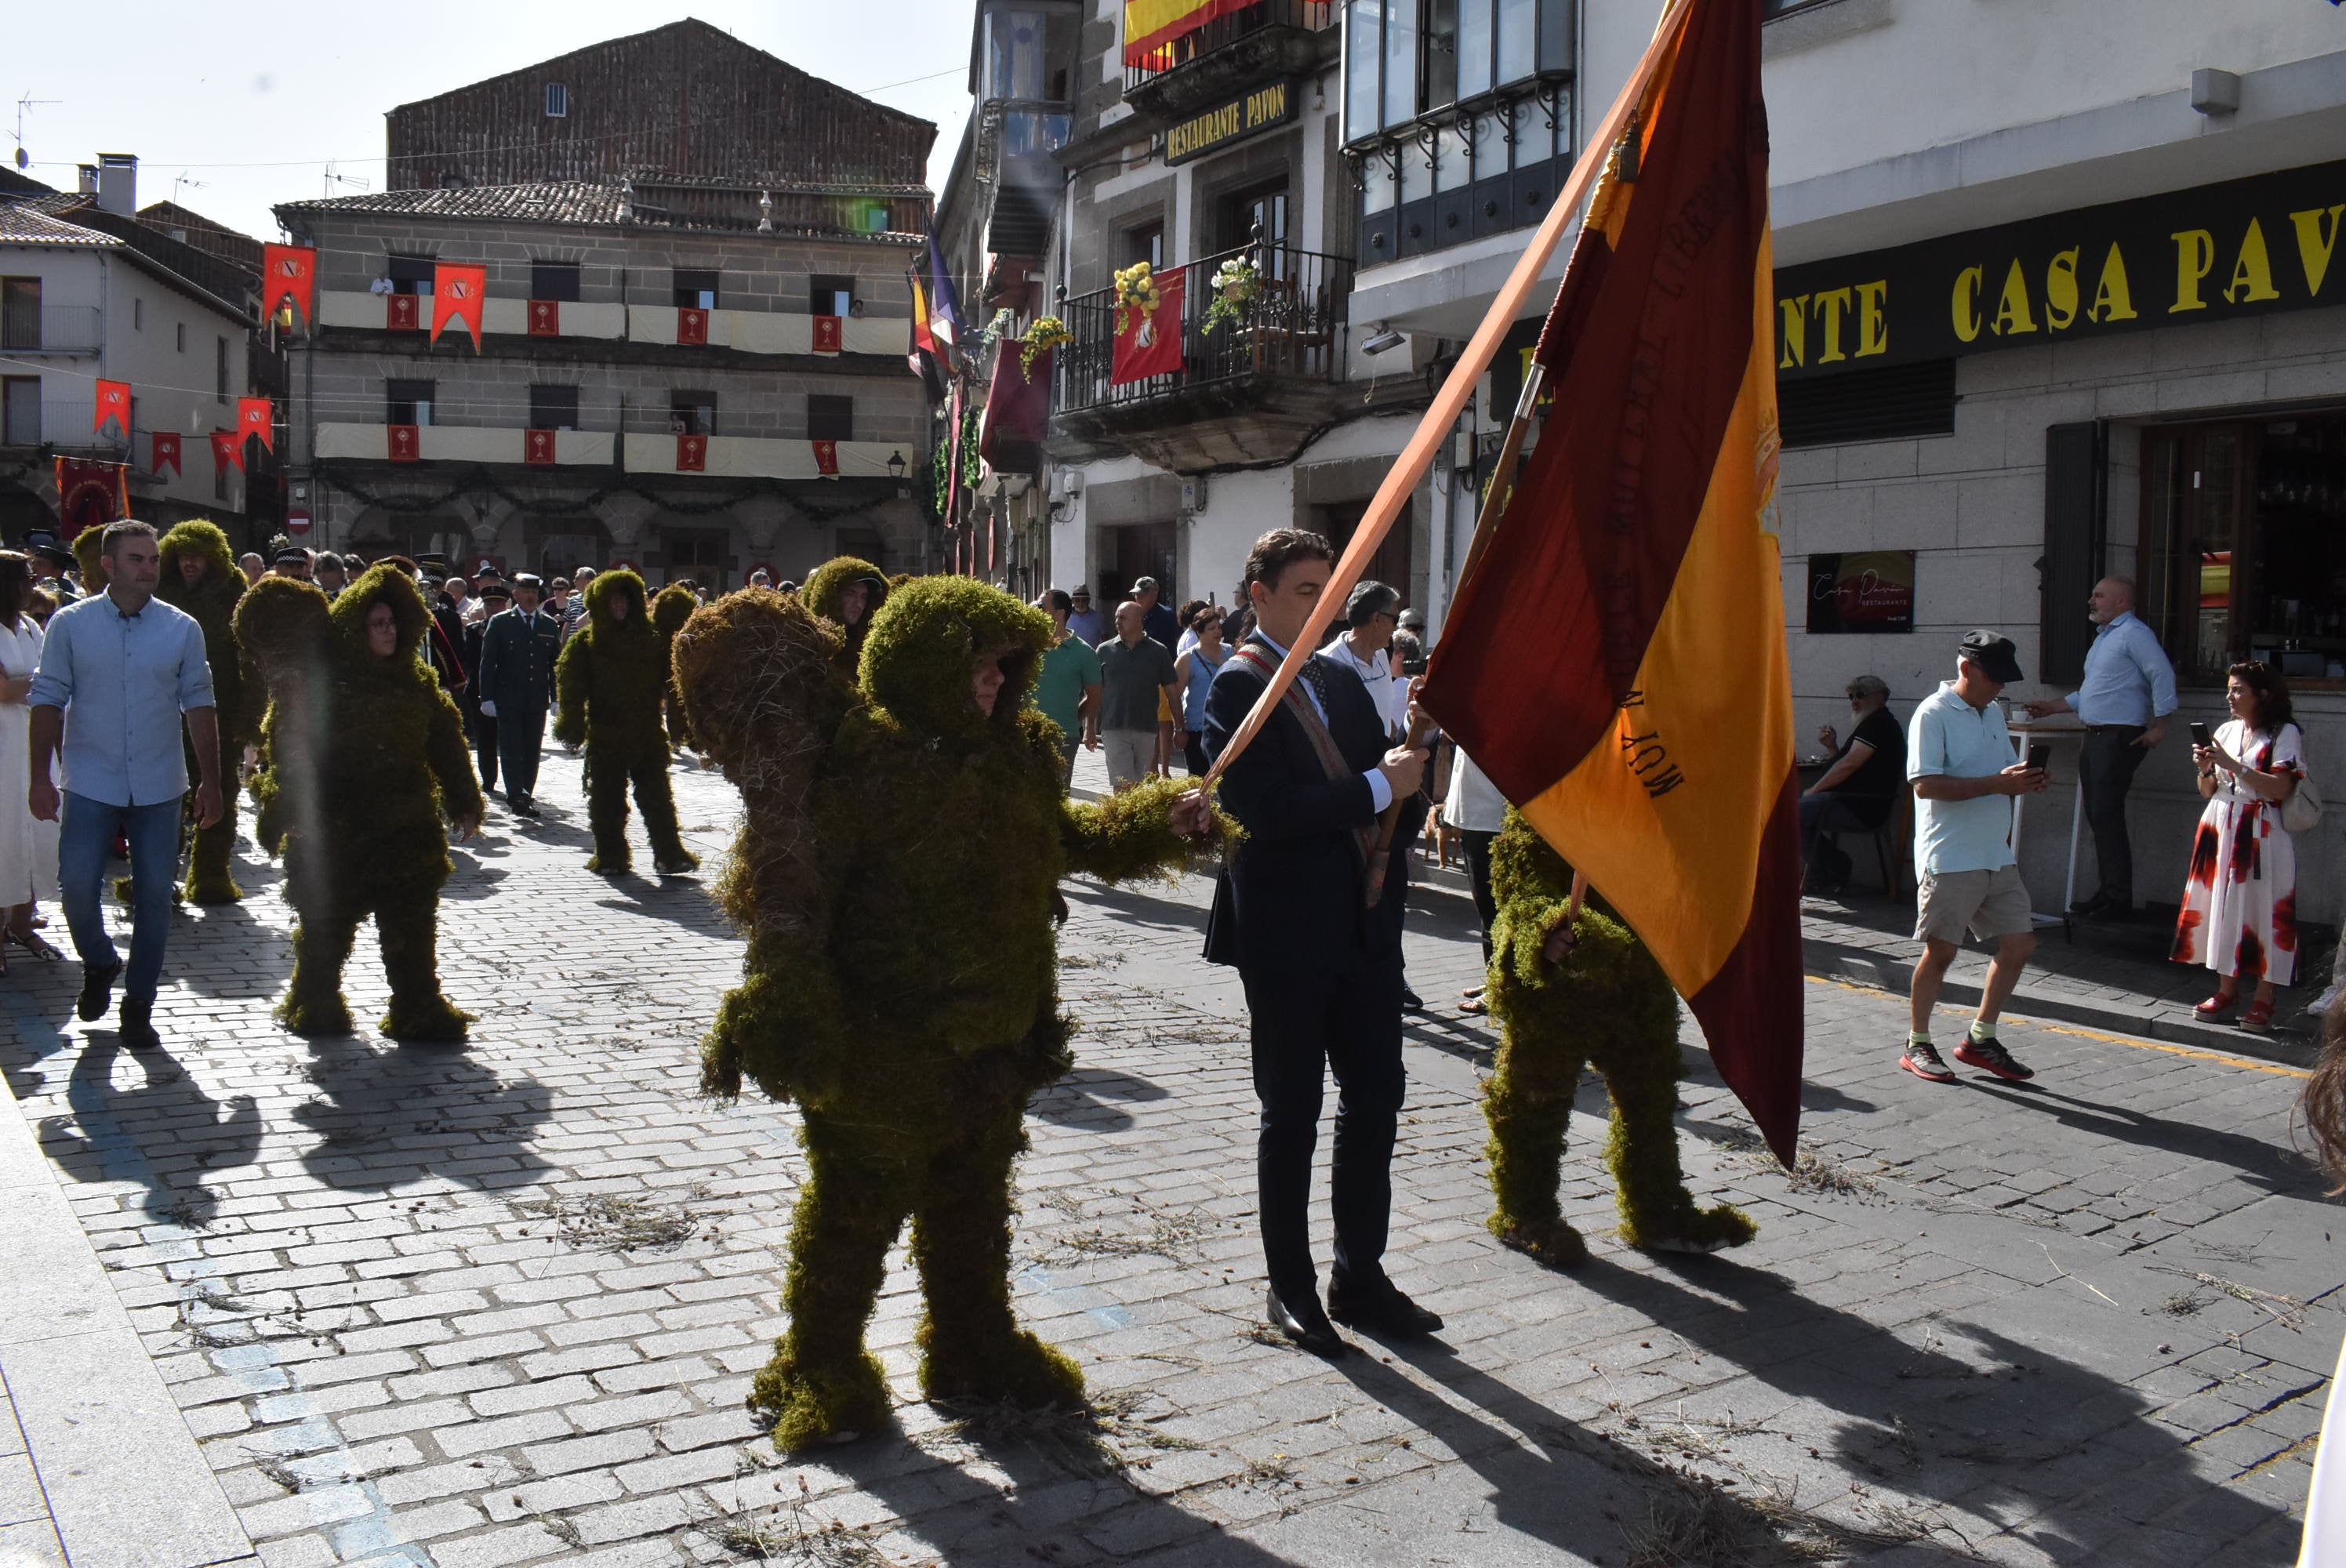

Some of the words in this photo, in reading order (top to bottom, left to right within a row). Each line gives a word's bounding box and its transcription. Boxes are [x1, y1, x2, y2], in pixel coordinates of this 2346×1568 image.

[1168, 101, 1239, 160] RESTAURANTE
[1247, 83, 1284, 128] PAVON
[1779, 279, 1887, 369] NTE
[1952, 241, 2137, 343] CASA
[1814, 573, 1854, 600] Casa
[1621, 731, 1685, 798] MUY
